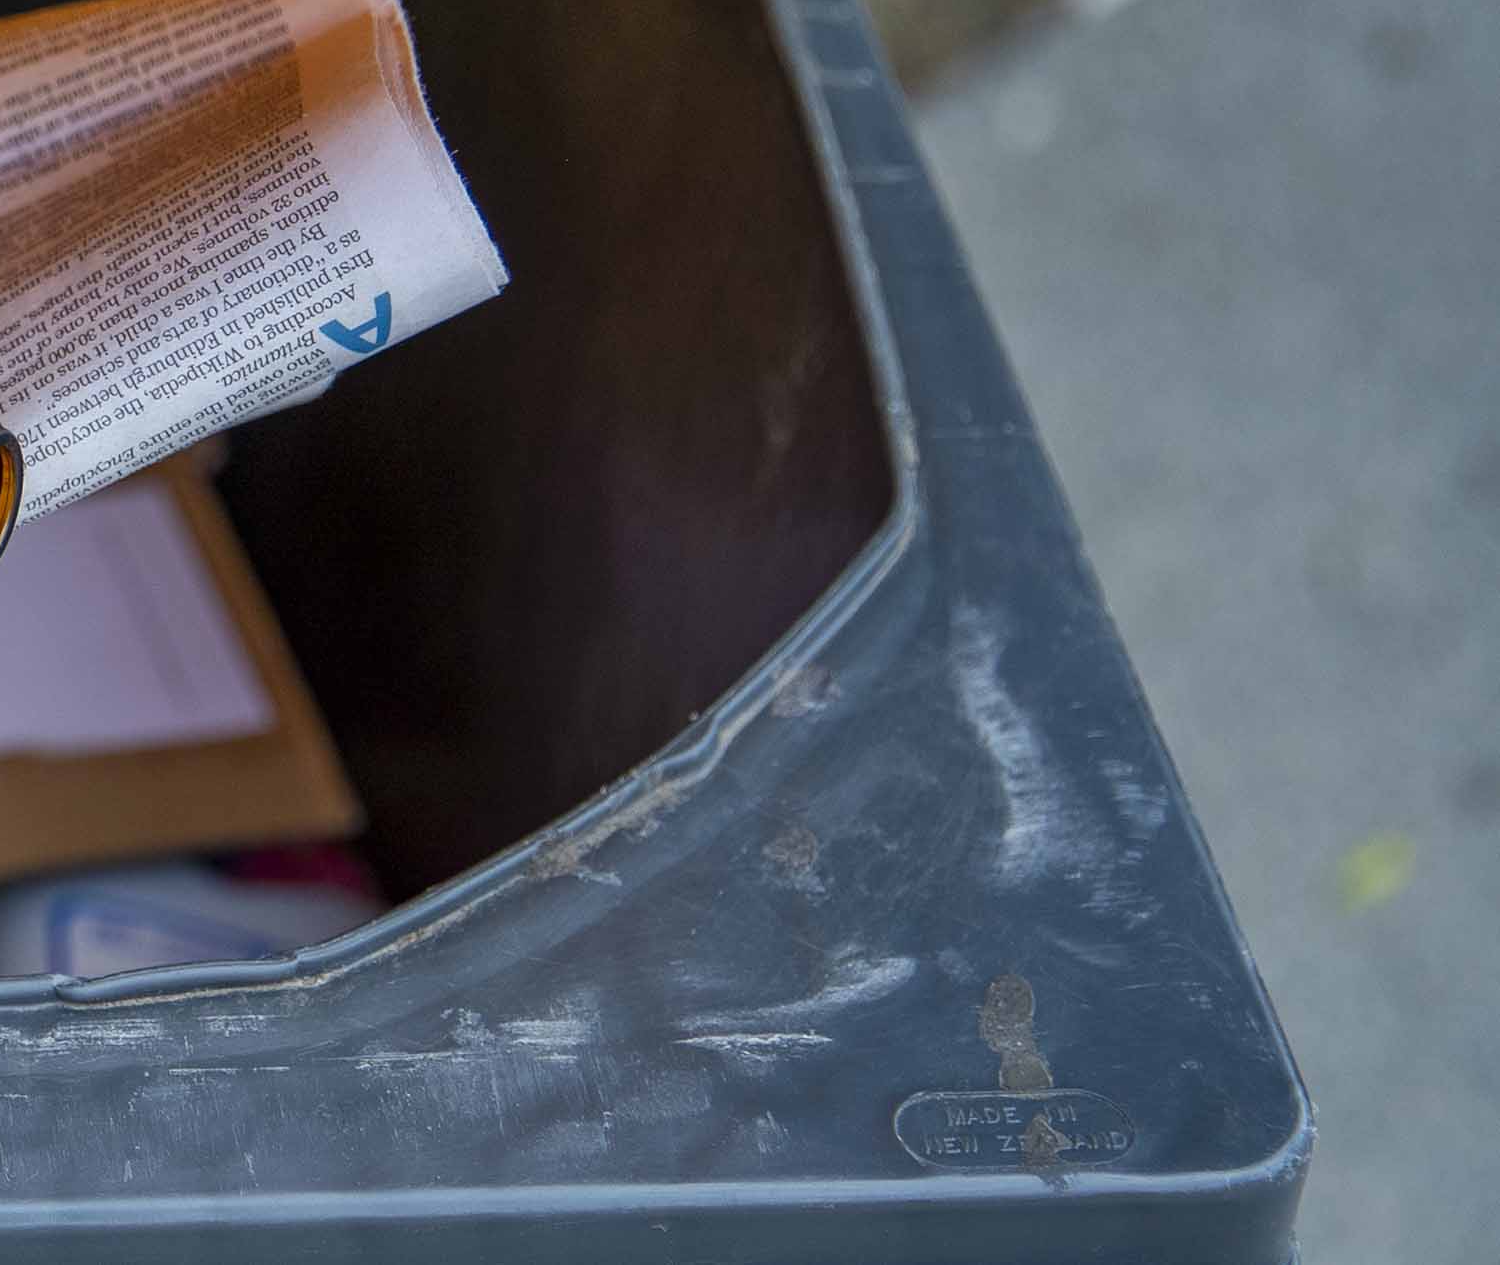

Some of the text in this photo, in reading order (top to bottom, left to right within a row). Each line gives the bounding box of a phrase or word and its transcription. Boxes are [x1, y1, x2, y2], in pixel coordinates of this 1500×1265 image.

[283, 140, 314, 164] the
[239, 159, 284, 191] floor
[242, 156, 321, 202] volumes,
[164, 196, 197, 220] and
[173, 185, 241, 230] flicking
[211, 202, 241, 226] but
[269, 189, 341, 234] edition,
[104, 227, 174, 272] through
[152, 225, 201, 260] spent
[265, 237, 298, 264] the
[298, 222, 326, 247] By
[187, 227, 269, 281] spanning
[3, 171, 330, 372] into 32 volumes. We only had one of the
[75, 268, 104, 291] the
[101, 257, 150, 291] many
[222, 255, 266, 287] time
[125, 228, 361, 365] as a of arts and
[139, 275, 186, 307] more
[174, 284, 211, 312] was
[48, 289, 102, 326] happy
[98, 304, 139, 334] than
[159, 303, 173, 319] a
[261, 282, 358, 342] According
[45, 249, 374, 431] first published in Edinburgh between
[108, 312, 161, 348] child,
[215, 290, 389, 390] A Britannica.
[242, 333, 261, 352] to
[55, 351, 92, 379] was
[93, 340, 109, 360] it
[284, 346, 325, 374] who
[32, 372, 55, 391] on
[143, 345, 243, 405] Wikipedia,
[225, 368, 284, 407] owned
[257, 357, 331, 404] growing
[7, 386, 31, 409] its
[111, 397, 145, 425] the
[193, 399, 224, 424] the
[231, 395, 255, 416] up
[137, 416, 193, 453] entire
[24, 445, 136, 514] Encyclopedia
[946, 1106, 1021, 1127] MADE
